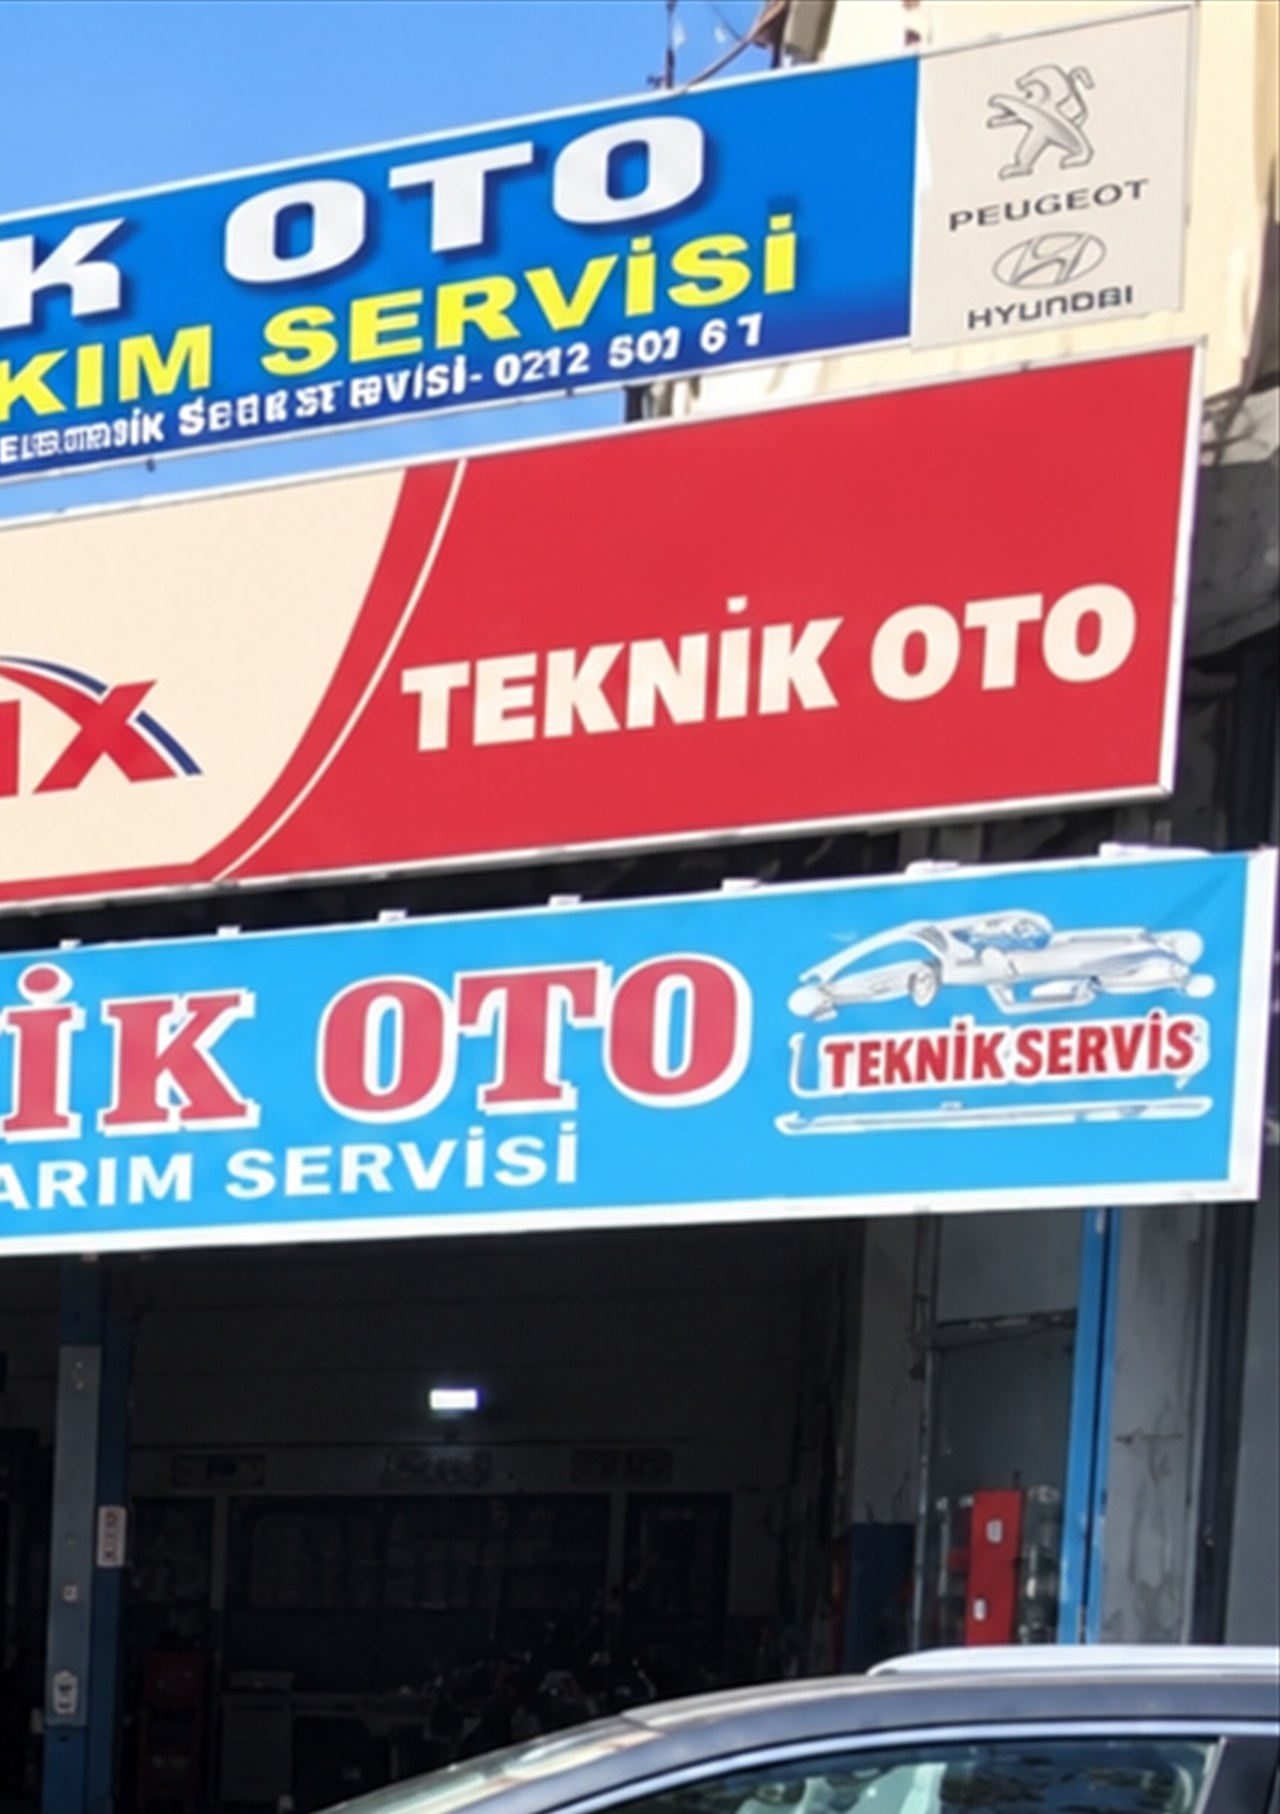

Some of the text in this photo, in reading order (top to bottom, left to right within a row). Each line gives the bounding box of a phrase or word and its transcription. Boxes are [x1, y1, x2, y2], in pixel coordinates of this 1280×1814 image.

[222, 113, 706, 285] OTO
[949, 178, 1150, 232] PEUGEOT
[259, 213, 797, 376] SERVİSİ
[401, 582, 1137, 753] TEKNİK OTO
[317, 952, 752, 1125] OTO
[824, 1011, 1195, 1089] TEKNİK SERVİS
[224, 1120, 580, 1200] SERVİSİ
